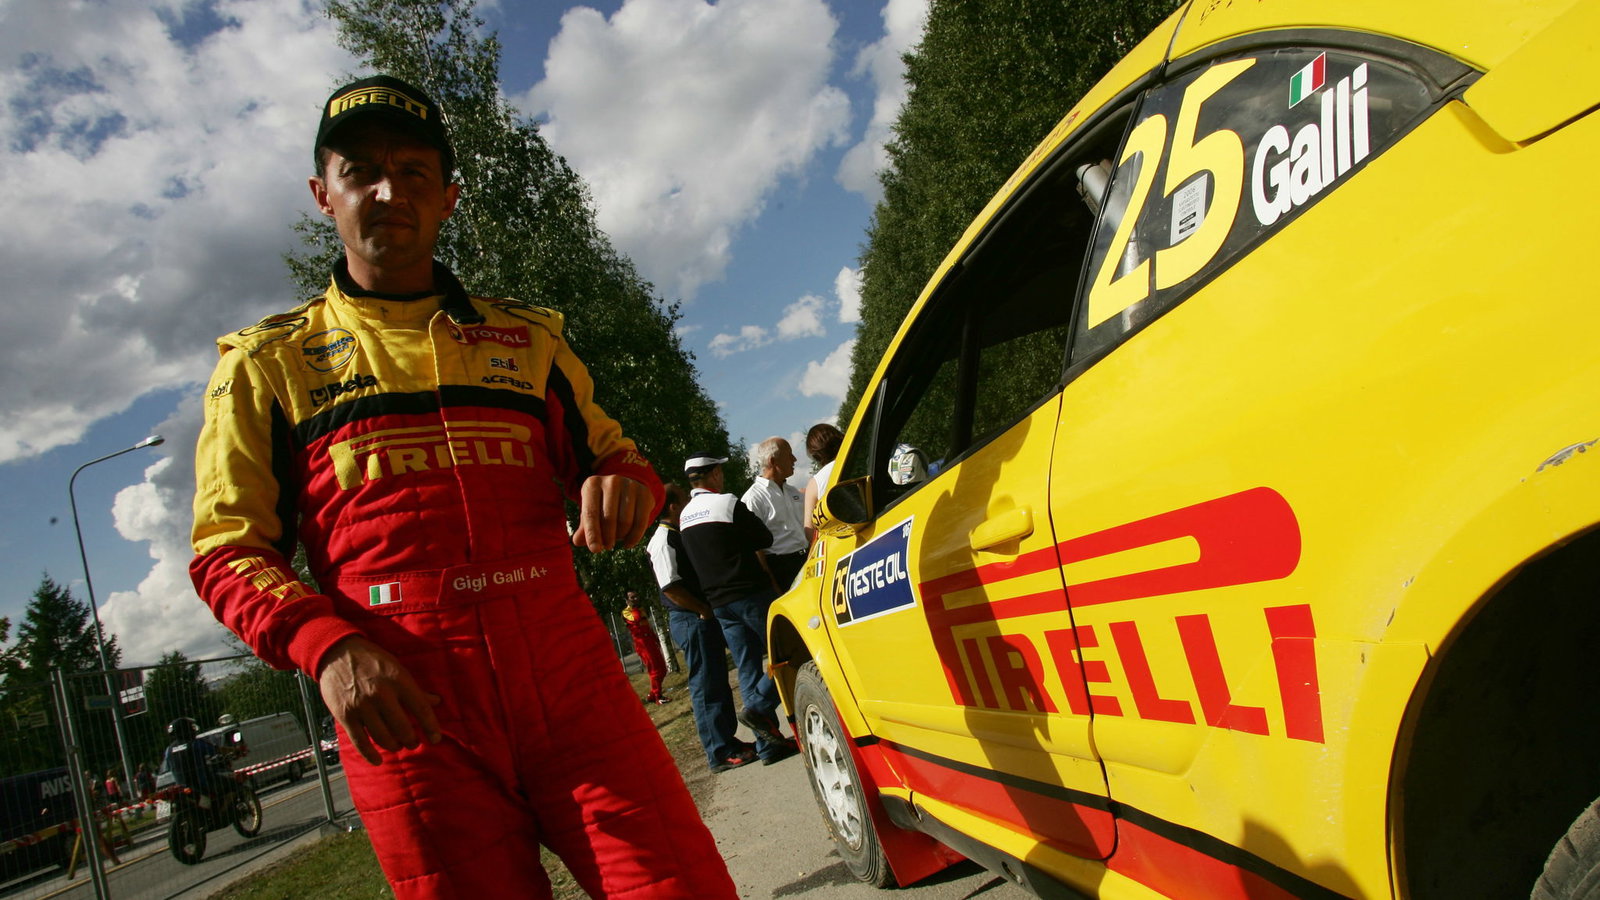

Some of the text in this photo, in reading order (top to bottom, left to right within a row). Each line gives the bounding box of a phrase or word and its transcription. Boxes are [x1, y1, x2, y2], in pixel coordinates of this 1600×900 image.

[329, 86, 428, 120] PIRELLI
[1252, 62, 1370, 226] Galli
[1088, 58, 1257, 330] 25
[466, 329, 528, 344] TOTAL
[326, 373, 377, 399] Beta
[329, 421, 535, 490] PIRELLI
[453, 566, 547, 592] Gigi Galli A+
[834, 566, 848, 615] 25
[848, 559, 885, 599] NESTE
[885, 551, 907, 584] OIL
[918, 486, 1325, 744] PIRELLI
[41, 776, 73, 799] AVIS
